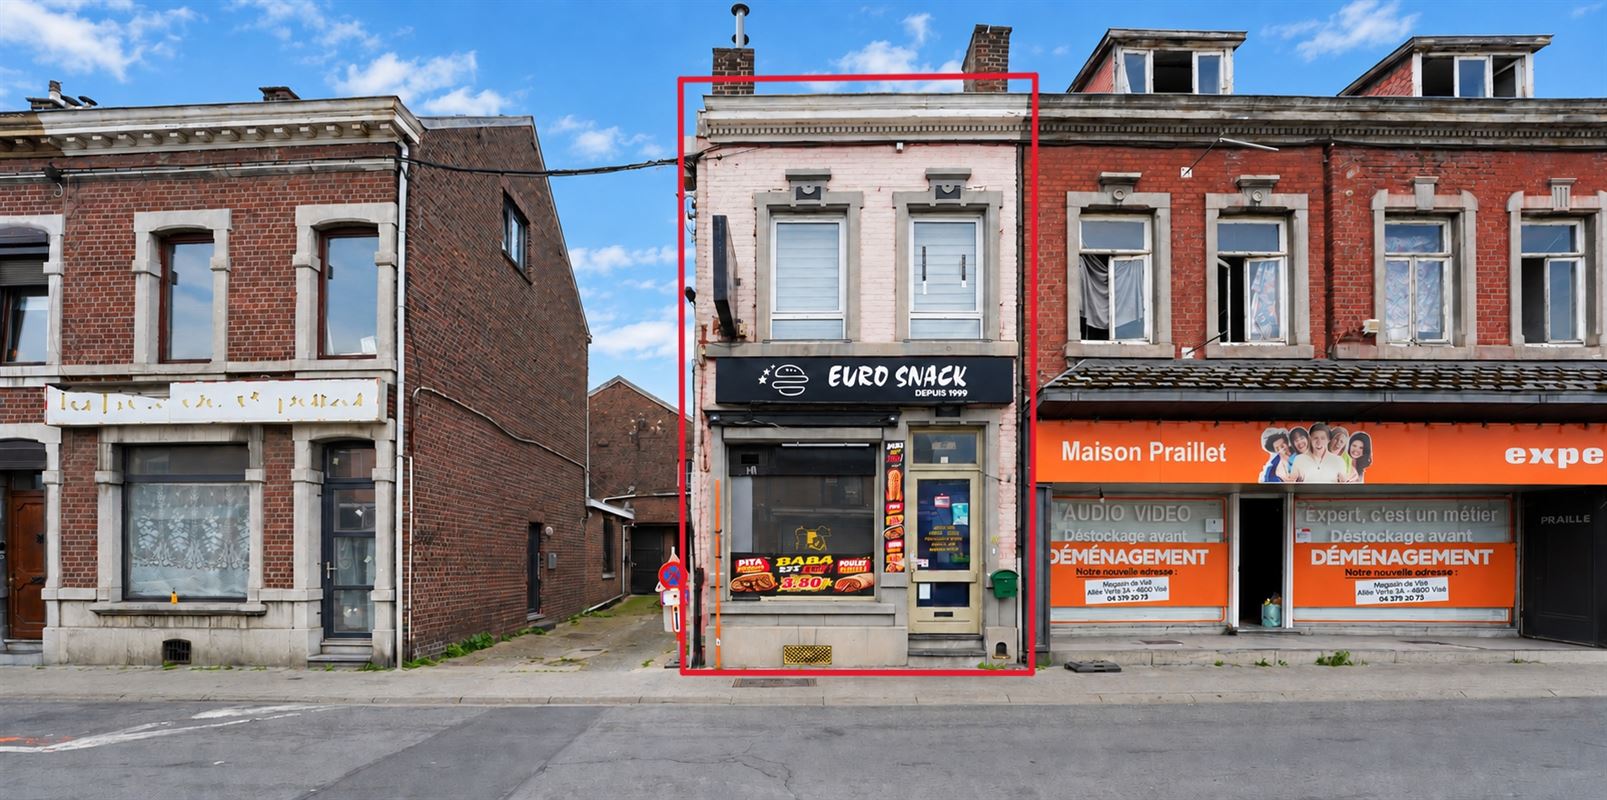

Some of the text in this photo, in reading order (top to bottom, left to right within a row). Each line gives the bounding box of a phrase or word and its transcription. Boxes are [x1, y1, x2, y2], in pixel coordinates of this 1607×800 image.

[828, 364, 968, 388] EURO SNACK
[915, 389, 968, 397] DEPUIS 1999
[1062, 440, 1227, 463] Maison Praillet
[1505, 447, 1604, 469] expe
[1063, 504, 1192, 522] AUDIO VIDEO
[1305, 507, 1498, 525] Expert, c'est un métier
[1064, 528, 1188, 544] Déstockage avant
[1331, 529, 1473, 545] Déstockage avant
[738, 558, 763, 566] PITA
[775, 555, 833, 567] BABA
[1050, 544, 1209, 565] DÉMÉNAGEMENT
[1311, 545, 1494, 566] DÉMÉNAGEMENT
[1076, 568, 1100, 576] Notre
[1102, 568, 1138, 576] nouvelle
[1140, 568, 1173, 576] adresse
[1345, 568, 1372, 576] Notre
[1374, 568, 1413, 576] nouvelle
[1415, 568, 1453, 576] adresse
[781, 575, 823, 588] 3.80
